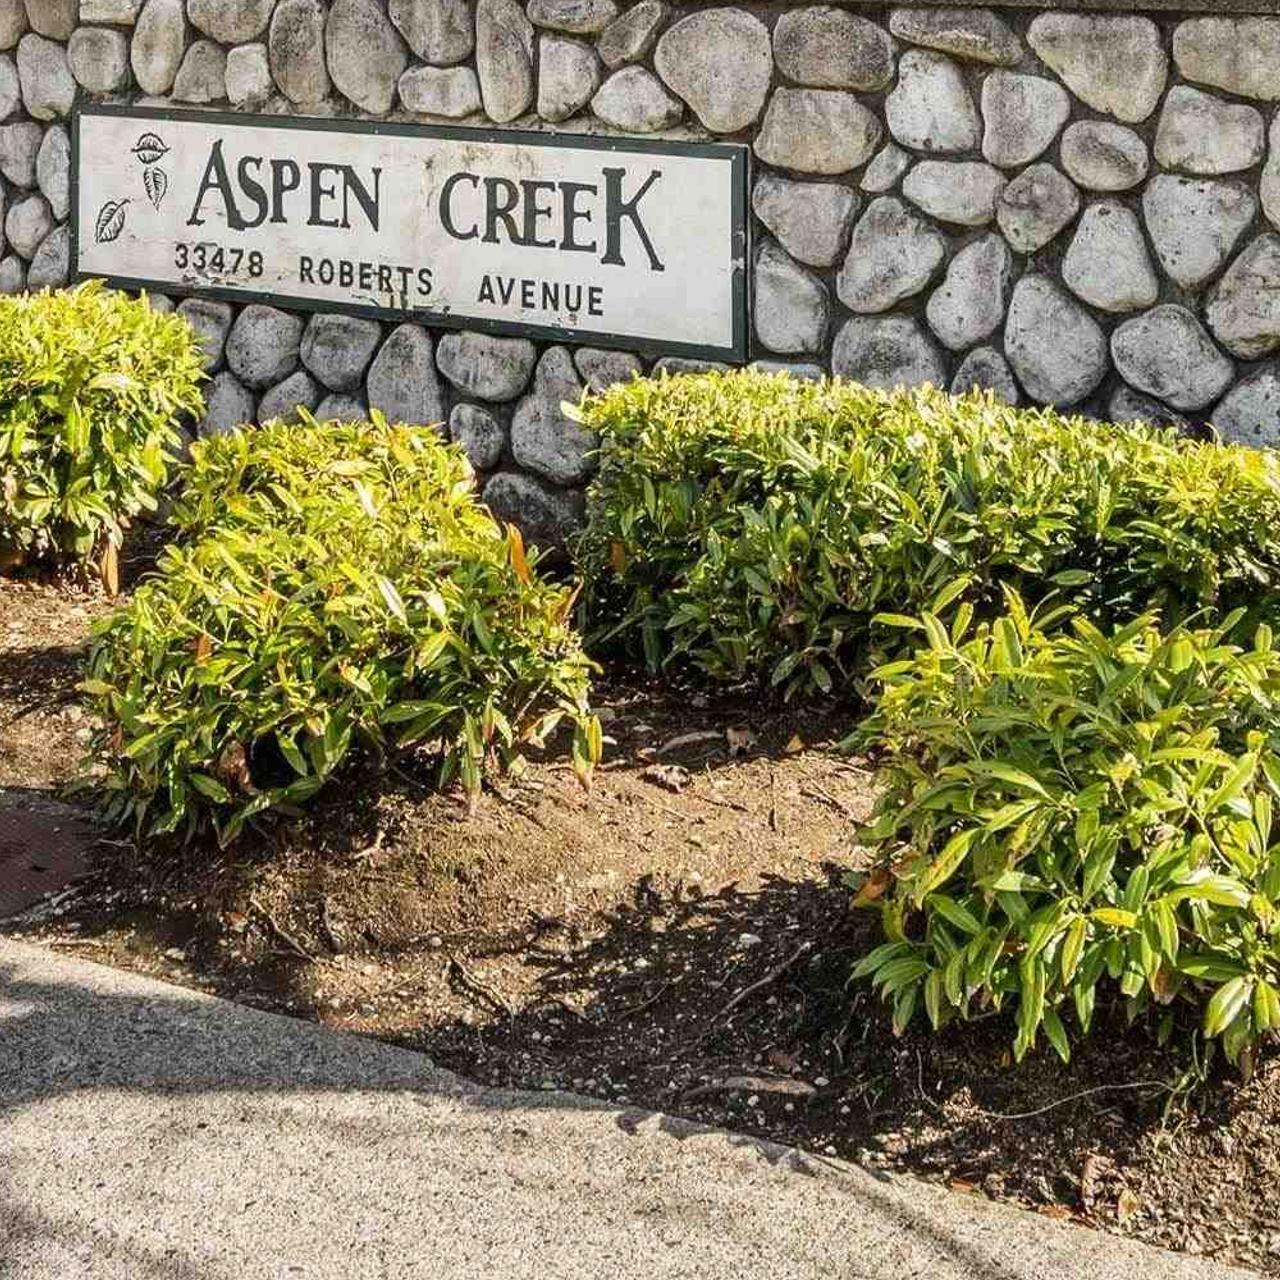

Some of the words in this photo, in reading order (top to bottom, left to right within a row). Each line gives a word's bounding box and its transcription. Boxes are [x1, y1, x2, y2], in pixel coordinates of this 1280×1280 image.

[186, 139, 382, 231] ASPEN
[439, 168, 665, 271] CREEK
[175, 243, 264, 277] 33478
[300, 256, 433, 296] ROBERTS
[478, 275, 604, 316] AVENUE
